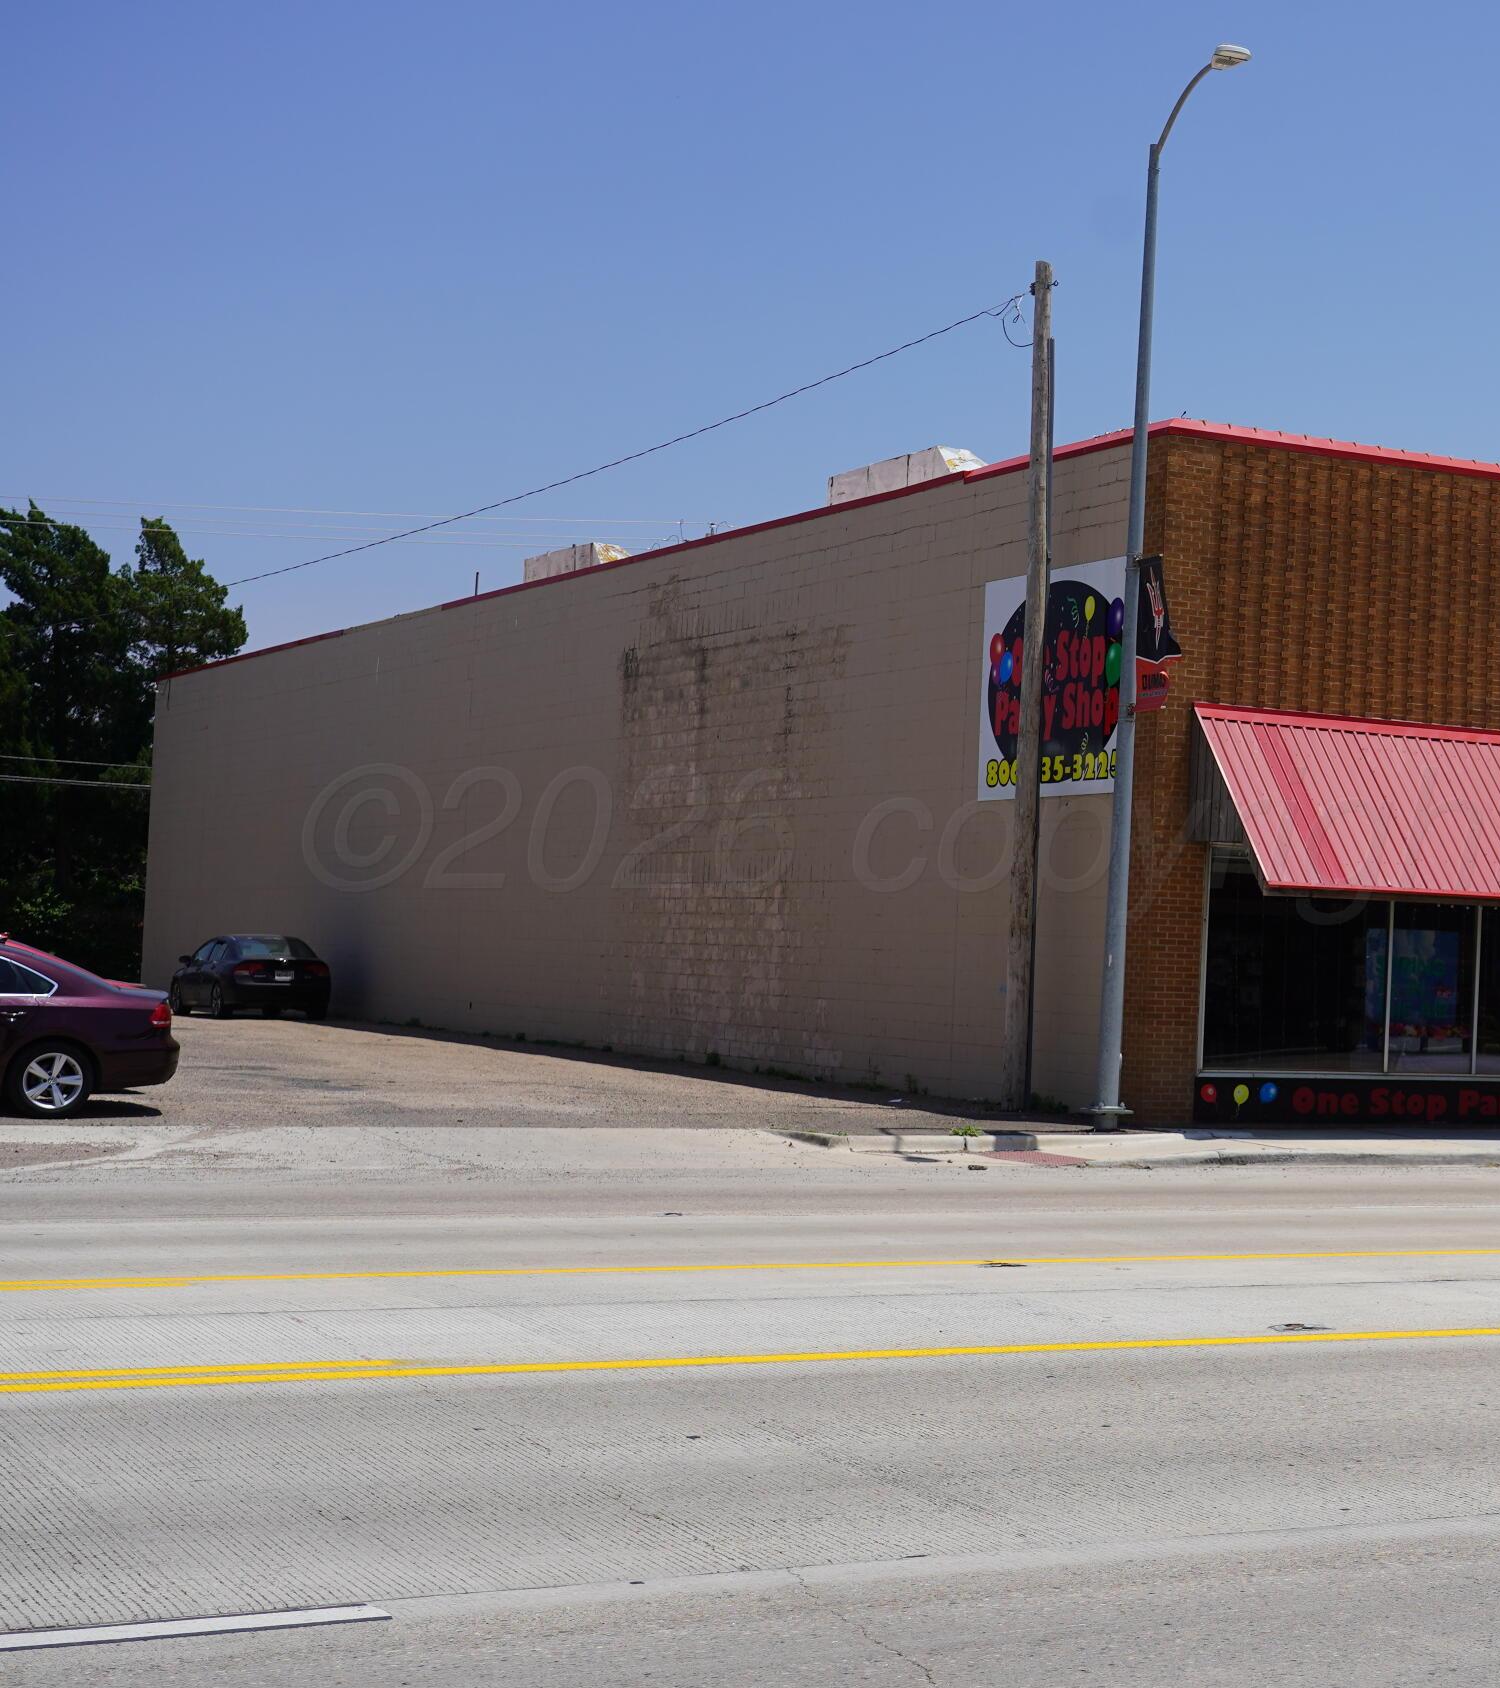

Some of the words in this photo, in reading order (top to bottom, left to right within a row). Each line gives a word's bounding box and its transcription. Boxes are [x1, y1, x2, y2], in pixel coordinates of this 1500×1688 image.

[1055, 630, 1106, 688] Stop
[994, 691, 1057, 742] Pay
[1062, 681, 1120, 736] Shop
[1292, 1086, 1360, 1116] One
[1369, 1087, 1448, 1121] Stop
